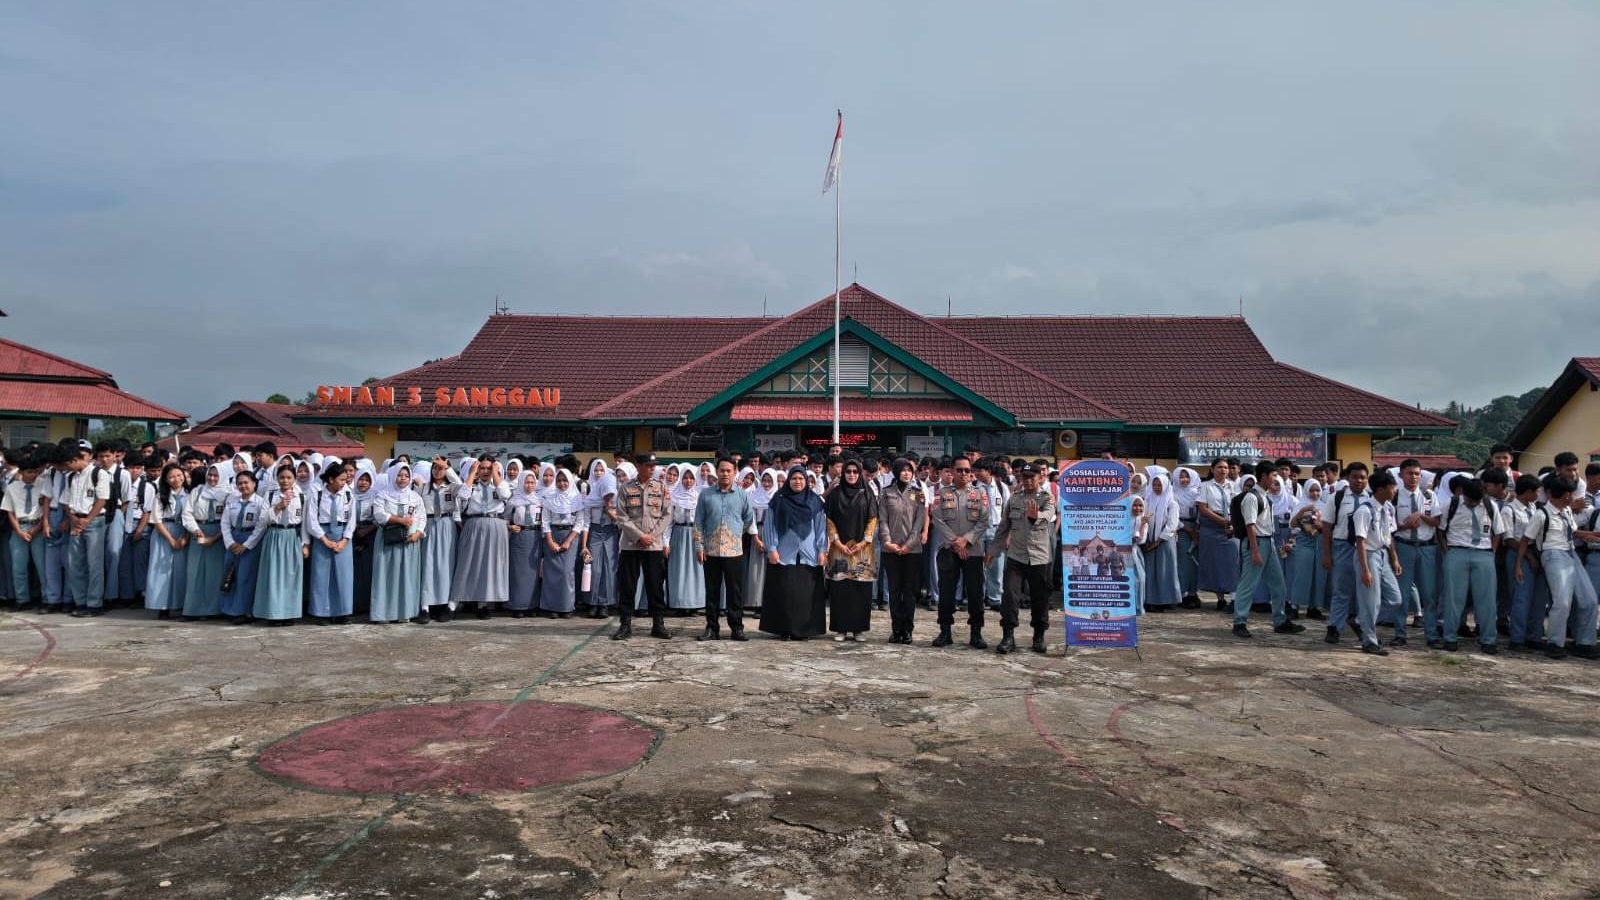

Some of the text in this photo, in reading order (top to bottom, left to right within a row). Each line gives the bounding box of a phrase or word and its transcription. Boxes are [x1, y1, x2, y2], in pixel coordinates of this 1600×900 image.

[316, 385, 560, 407] SMAN 3 SANGGAU
[1189, 449, 1312, 458] MATI MASUK NERAKA
[1064, 477, 1124, 486] KAMTIBNAS
